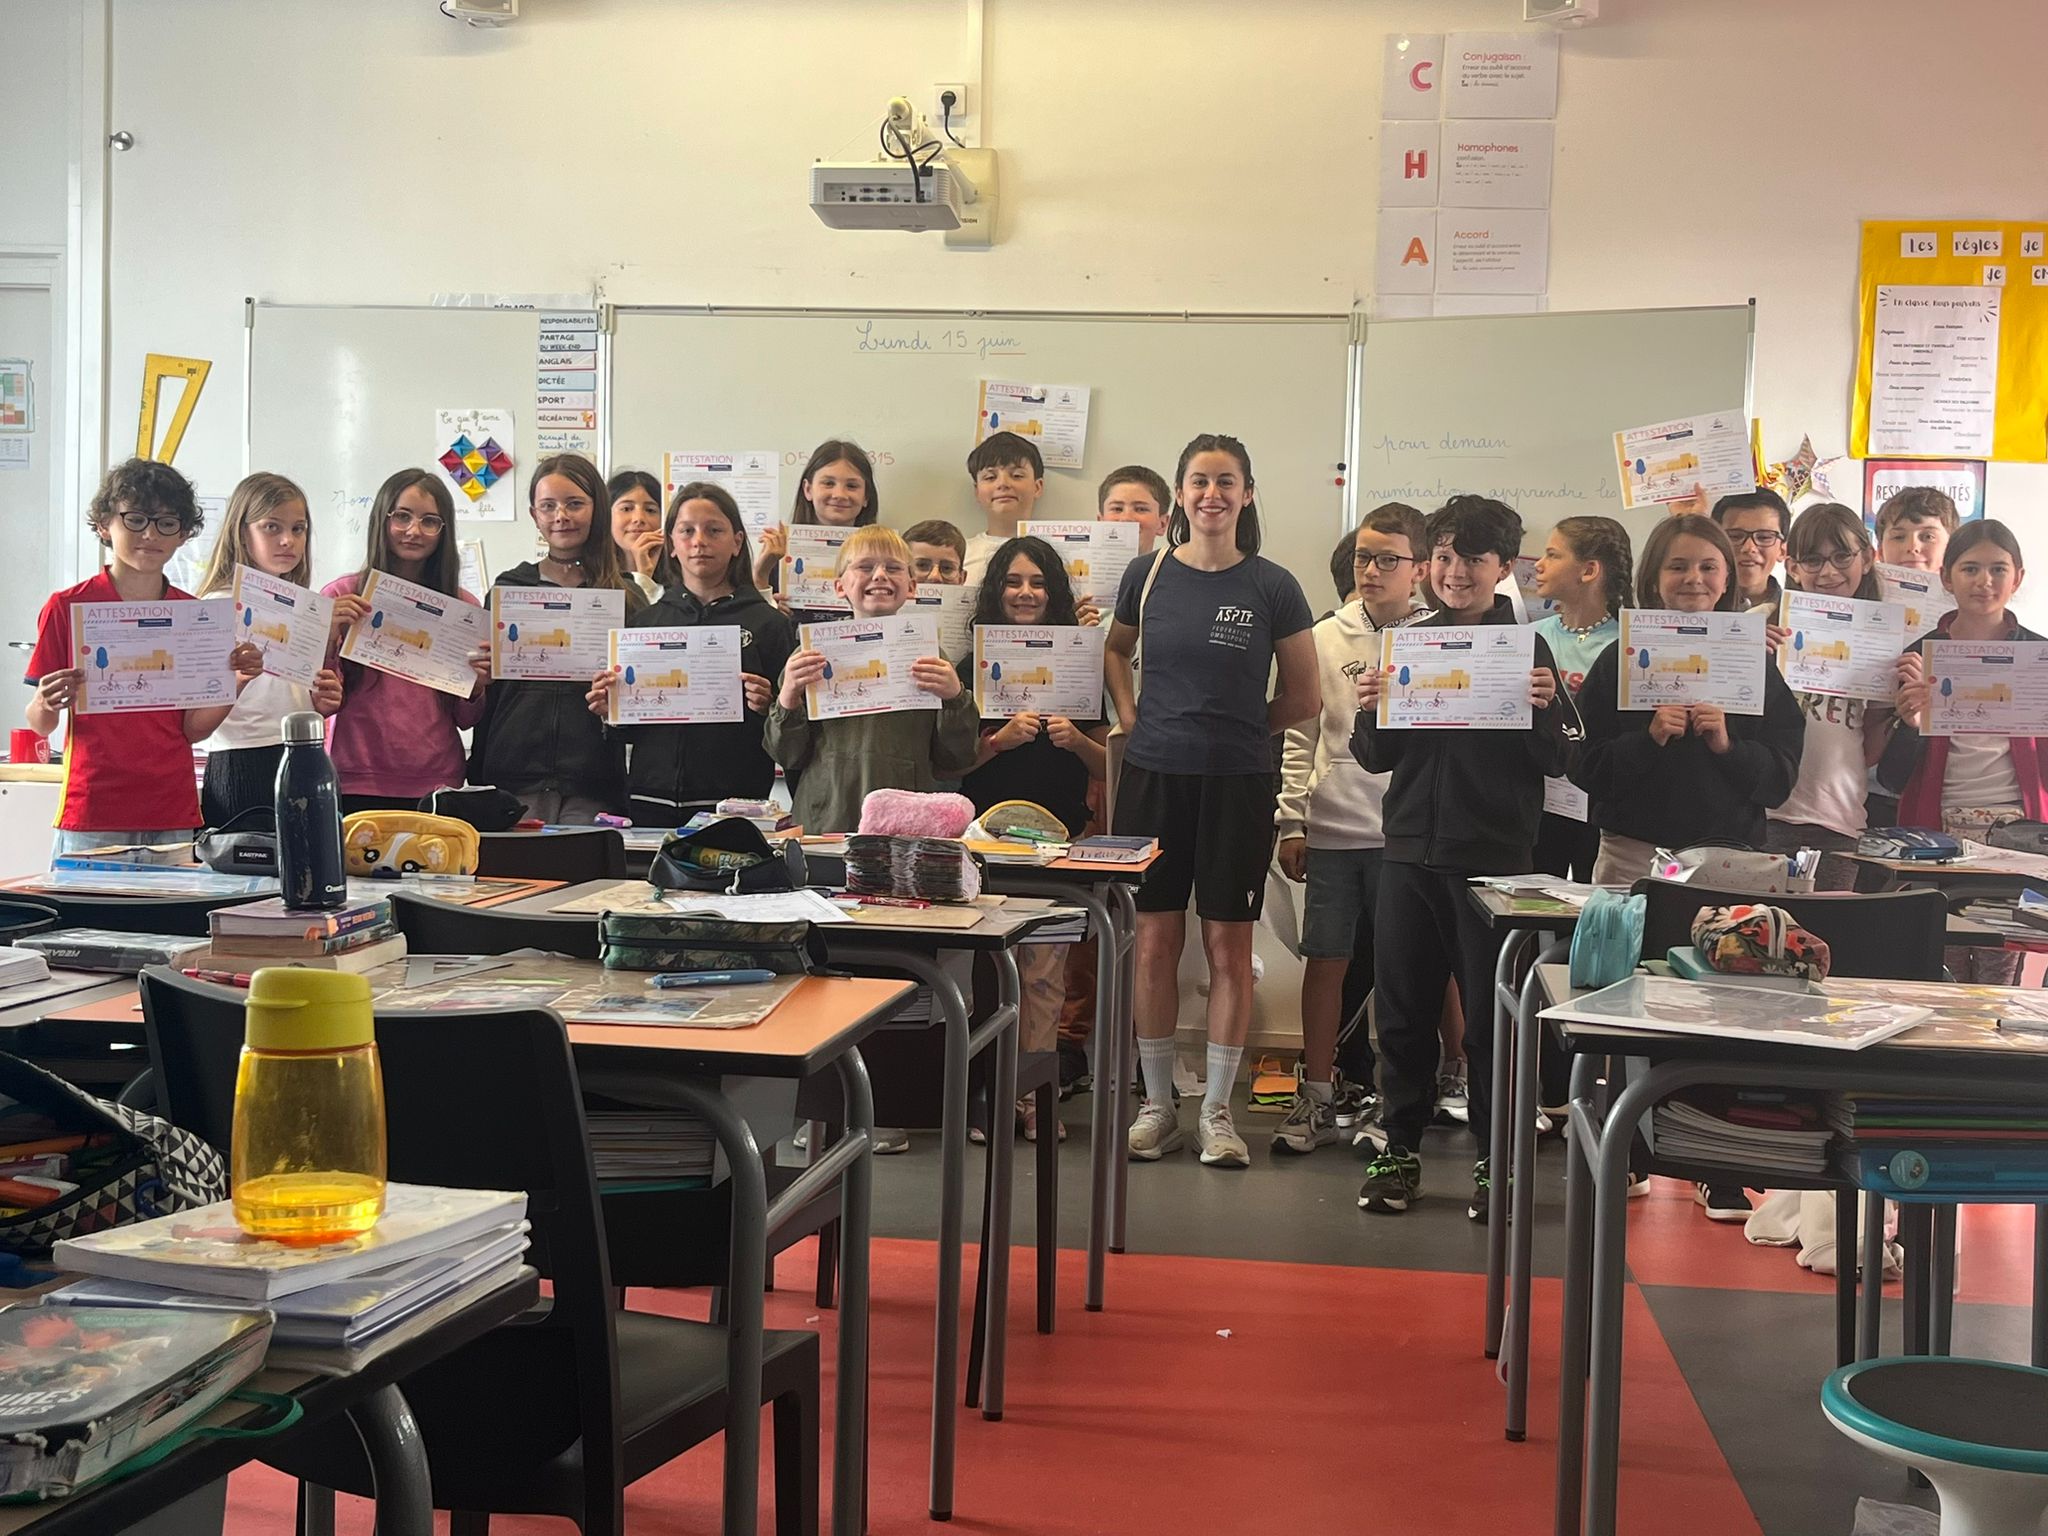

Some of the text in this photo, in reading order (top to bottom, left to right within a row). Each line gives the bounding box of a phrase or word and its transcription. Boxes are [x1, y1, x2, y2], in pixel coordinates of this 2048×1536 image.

[1462, 51, 1521, 63] Conjugaison
[1410, 61, 1433, 91] C
[1457, 142, 1519, 154] Homophones
[1404, 150, 1427, 179] H
[1453, 230, 1489, 240] Accord
[1401, 237, 1429, 266] A
[540, 317, 595, 325] RESPONSABILITÉS
[539, 334, 575, 342] PARTAGE
[855, 320, 1022, 360] Lundi 15 juin
[538, 376, 566, 385] DICTÉE
[537, 396, 566, 405] SPORT
[538, 414, 578, 422] RÉCRÉATION
[1626, 421, 1694, 441] ATTESTATION
[1373, 431, 1512, 464] pour demain
[673, 454, 734, 464] ATTESTATION
[1029, 523, 1092, 534] ATTESTATION
[244, 572, 297, 598] ATTESTATION
[380, 578, 449, 609] ATTESTATION
[503, 590, 573, 602] ATTESTATION
[1791, 595, 1855, 613] ATTESTATION
[88, 606, 173, 618] ATTESTATION
[1633, 614, 1709, 626] ATTESTATION
[813, 622, 884, 637] ATTESTATION
[986, 629, 1055, 640] ATTESTATION
[620, 631, 689, 643] ATTESTATION
[1396, 630, 1474, 642] ATTESTATION
[1937, 645, 2016, 655] ATTESTATION
[238, 851, 268, 859] EASTPAK
